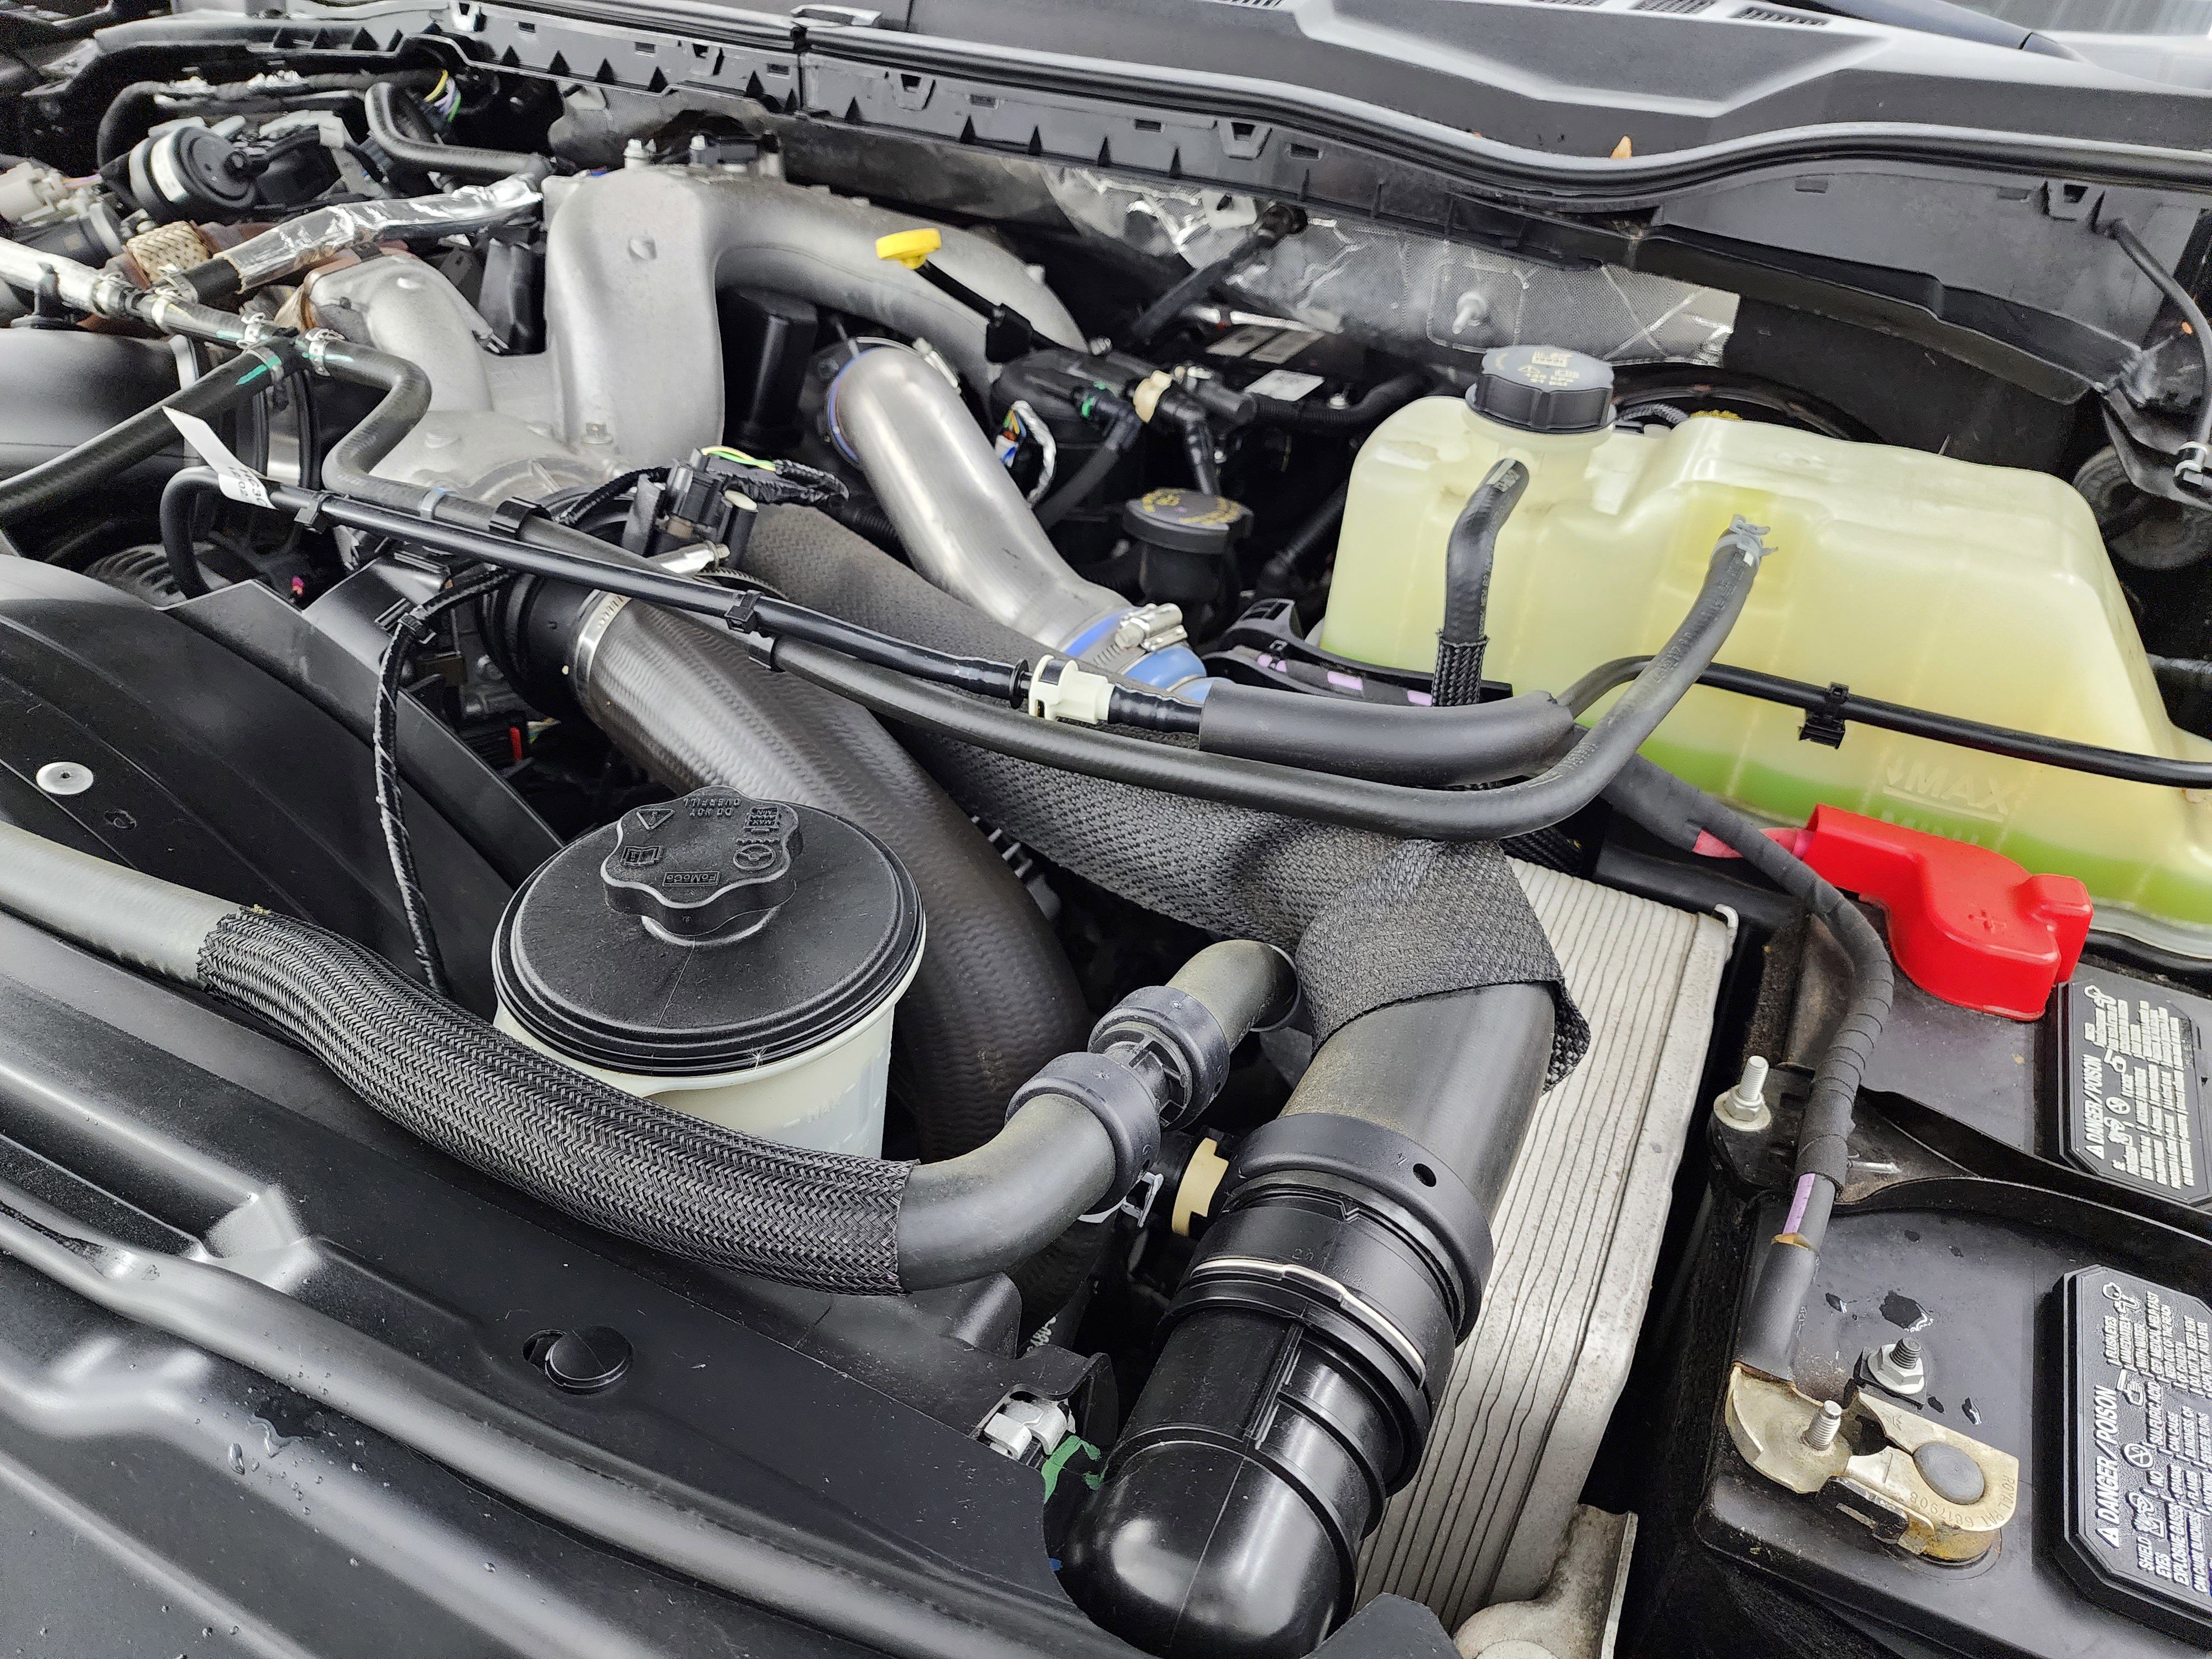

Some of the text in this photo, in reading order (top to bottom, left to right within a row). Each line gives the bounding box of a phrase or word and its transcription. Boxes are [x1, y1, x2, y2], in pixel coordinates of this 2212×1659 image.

[1903, 760, 2011, 816] MAX
[666, 873, 717, 884] FoMoCo
[2104, 1315, 2117, 1335] EYES
[2147, 1381, 2163, 1445] SULFURIC ACID
[2183, 1418, 2197, 1459] BLINDNESS
[1997, 1474, 2015, 1509] ROYAL
[2150, 1470, 2164, 1488] NO
[2137, 1536, 2154, 1572] SHIELD
[2168, 1503, 2190, 1587] EXPLOSIVE GASES
[2154, 1552, 2171, 1579] EYES
